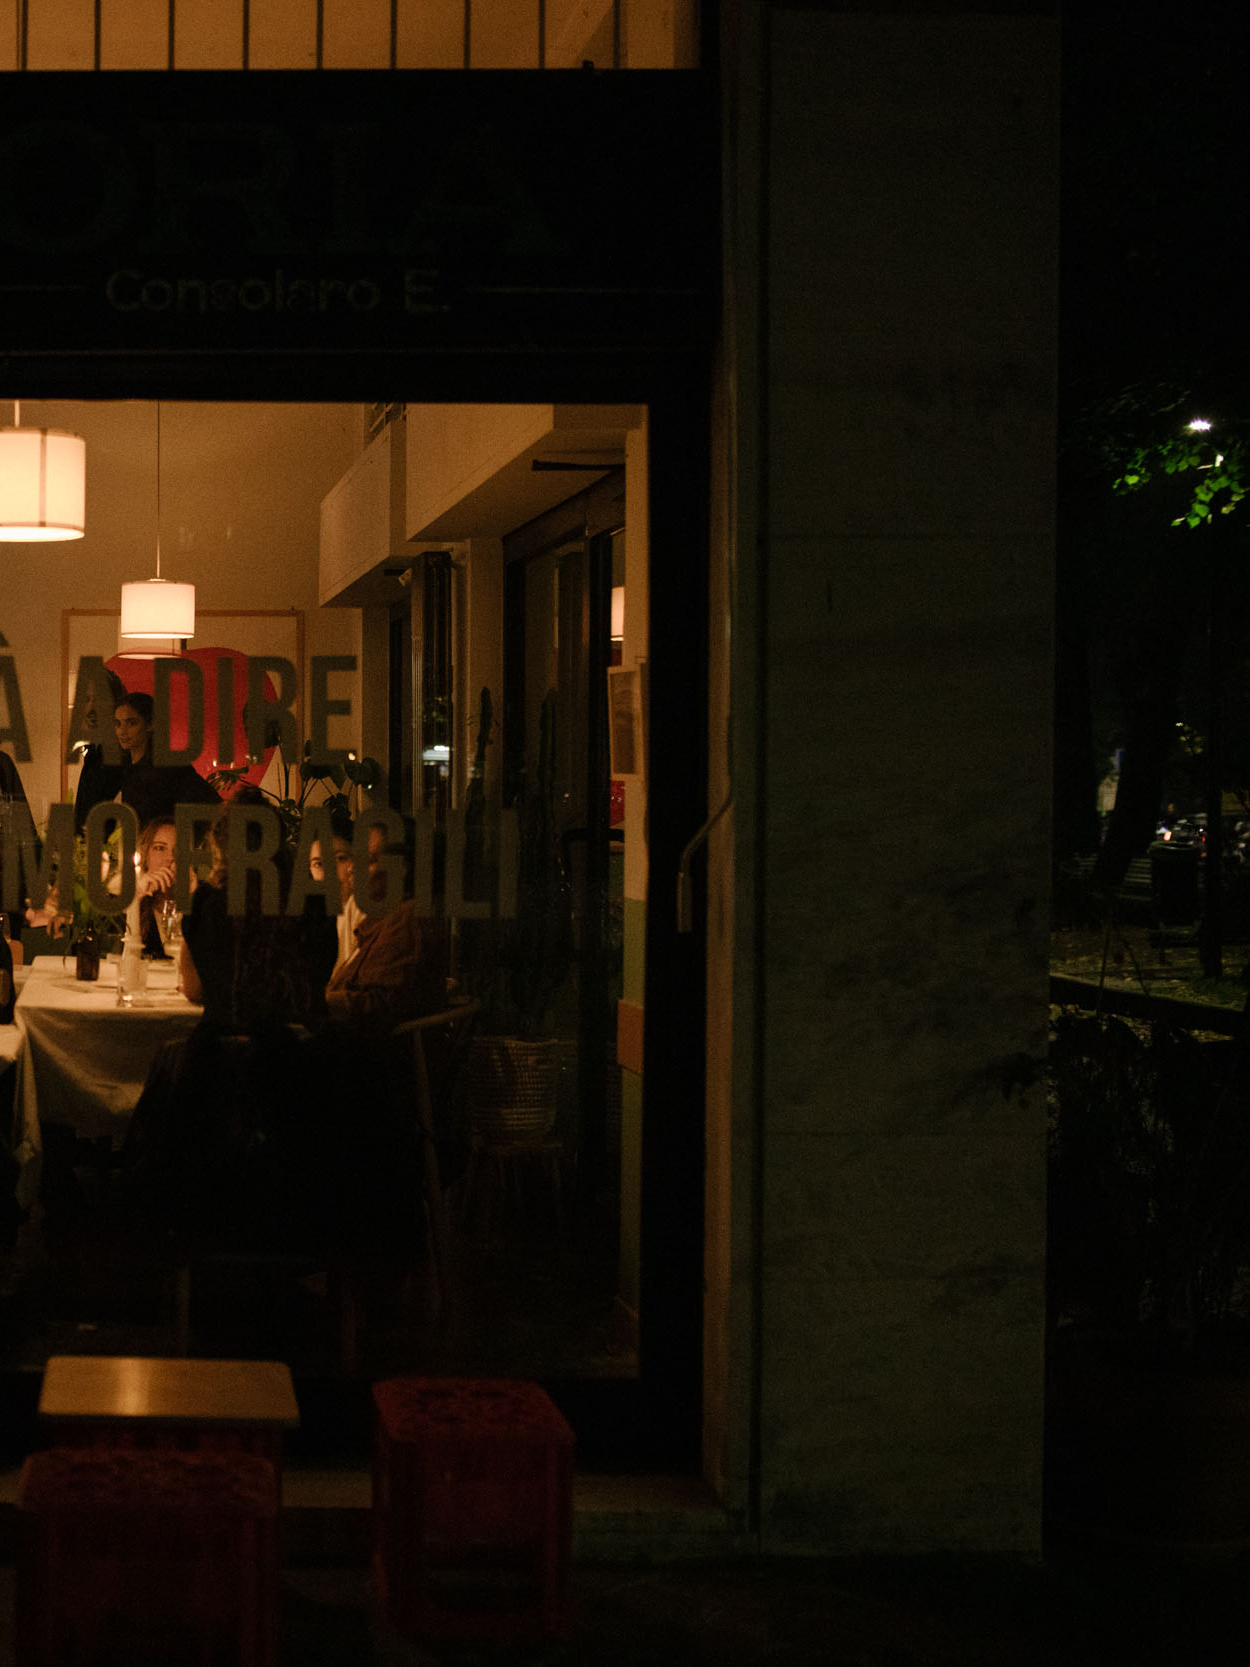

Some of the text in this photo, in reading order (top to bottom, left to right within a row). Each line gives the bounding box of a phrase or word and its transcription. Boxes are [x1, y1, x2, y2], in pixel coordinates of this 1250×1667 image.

[405, 269, 452, 313] E.
[68, 656, 124, 766] A
[150, 655, 358, 768] DIRE
[172, 804, 520, 922] FRAGILI
